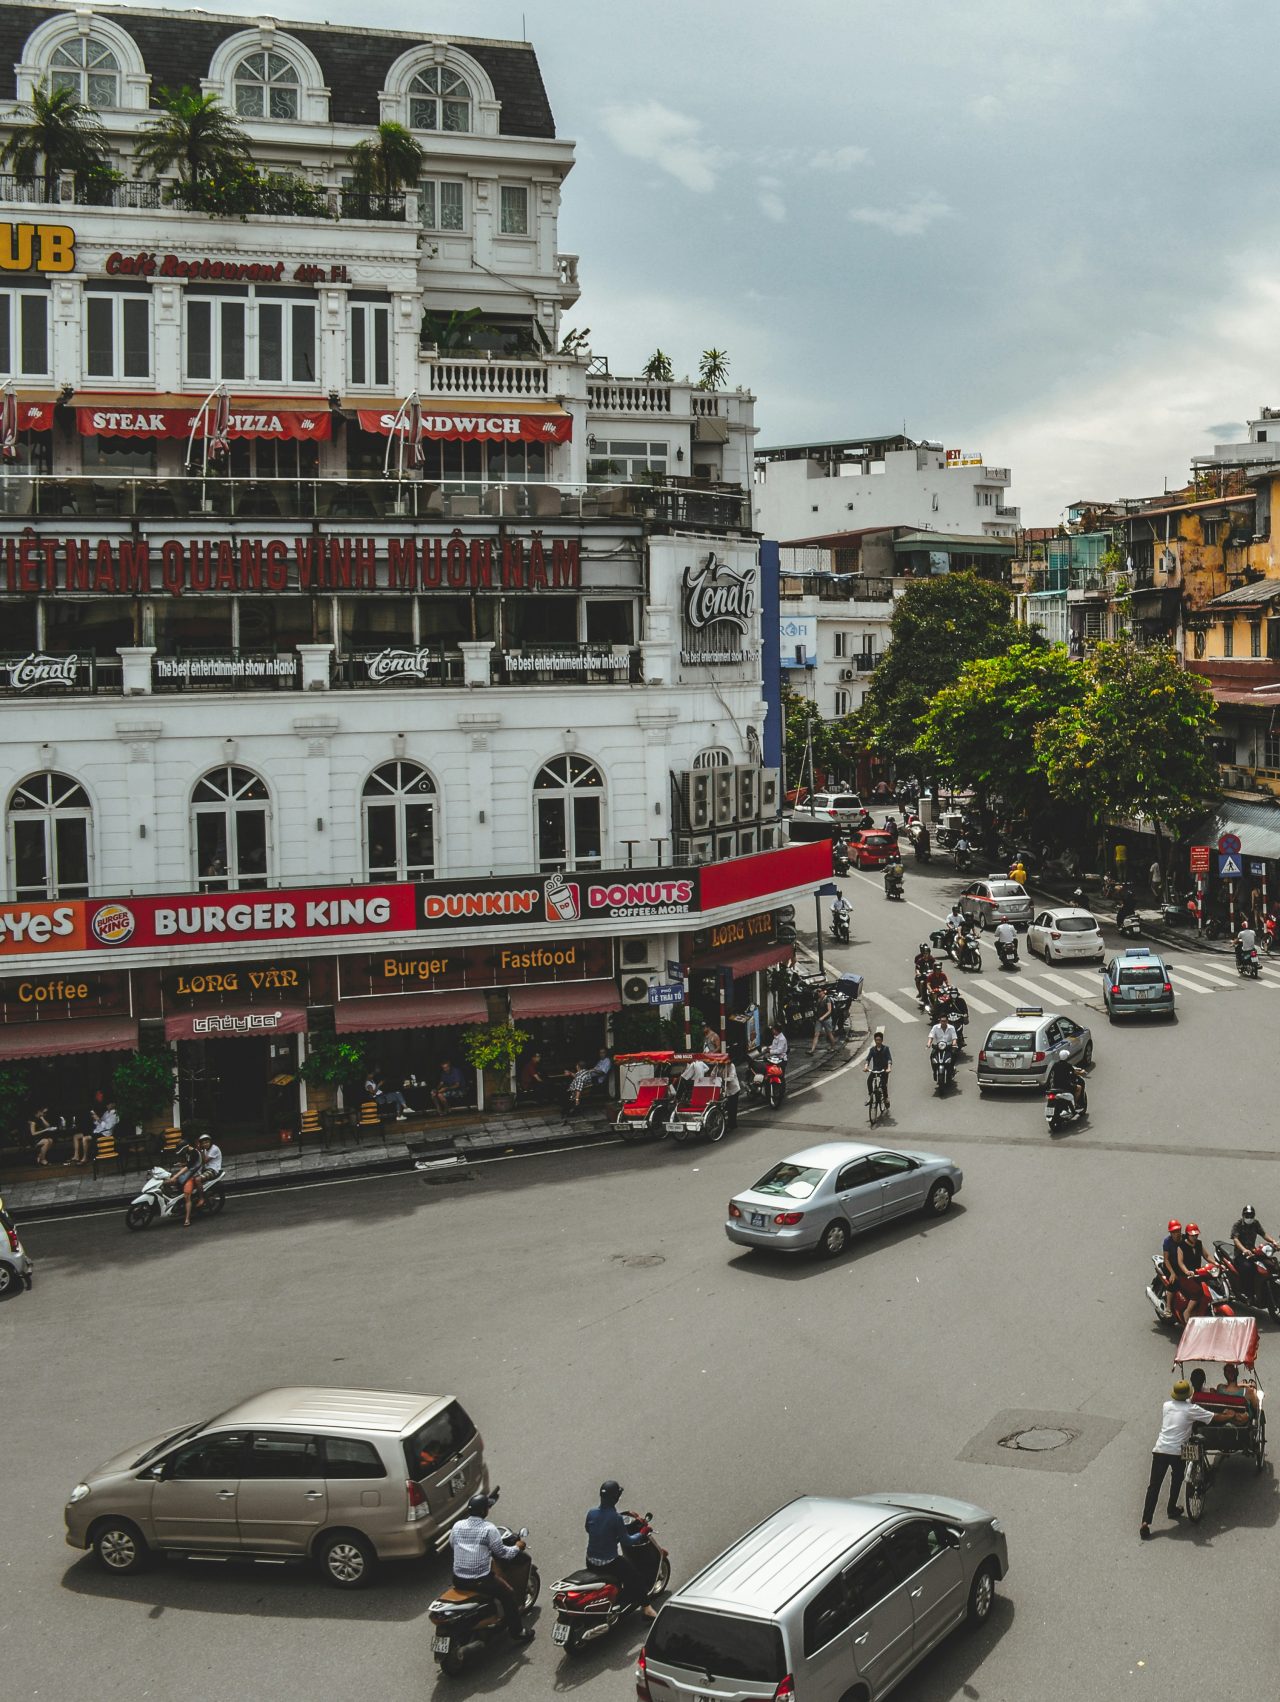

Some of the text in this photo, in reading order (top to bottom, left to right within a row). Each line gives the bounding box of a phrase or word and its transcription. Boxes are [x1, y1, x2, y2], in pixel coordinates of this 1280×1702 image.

[106, 251, 156, 277] Café
[160, 254, 285, 281] Restaurant
[294, 263, 326, 282] 4th
[93, 412, 166, 431] STEAK
[227, 414, 284, 432] PIZZA
[380, 414, 521, 434] SANDWICH
[66, 539, 149, 592] NAM
[162, 539, 288, 598] QUANG
[295, 537, 376, 591] VINH
[388, 528, 492, 590] MUÔN
[502, 530, 582, 589] NĂM
[158, 659, 297, 677] The best entertainment show in Hanoi
[505, 653, 630, 671] The best entertainment show in Hanoi
[425, 889, 539, 919] DUNKIN'
[588, 880, 692, 908] DONUTS
[97, 911, 129, 927] BURGER
[99, 917, 130, 936] KING
[155, 897, 391, 936] BURGER KING
[384, 947, 575, 980] Burger Fastfood
[177, 966, 299, 994] LONG VÂN
[19, 980, 88, 1002] Coffee
[660, 992, 673, 1002] THÁI
